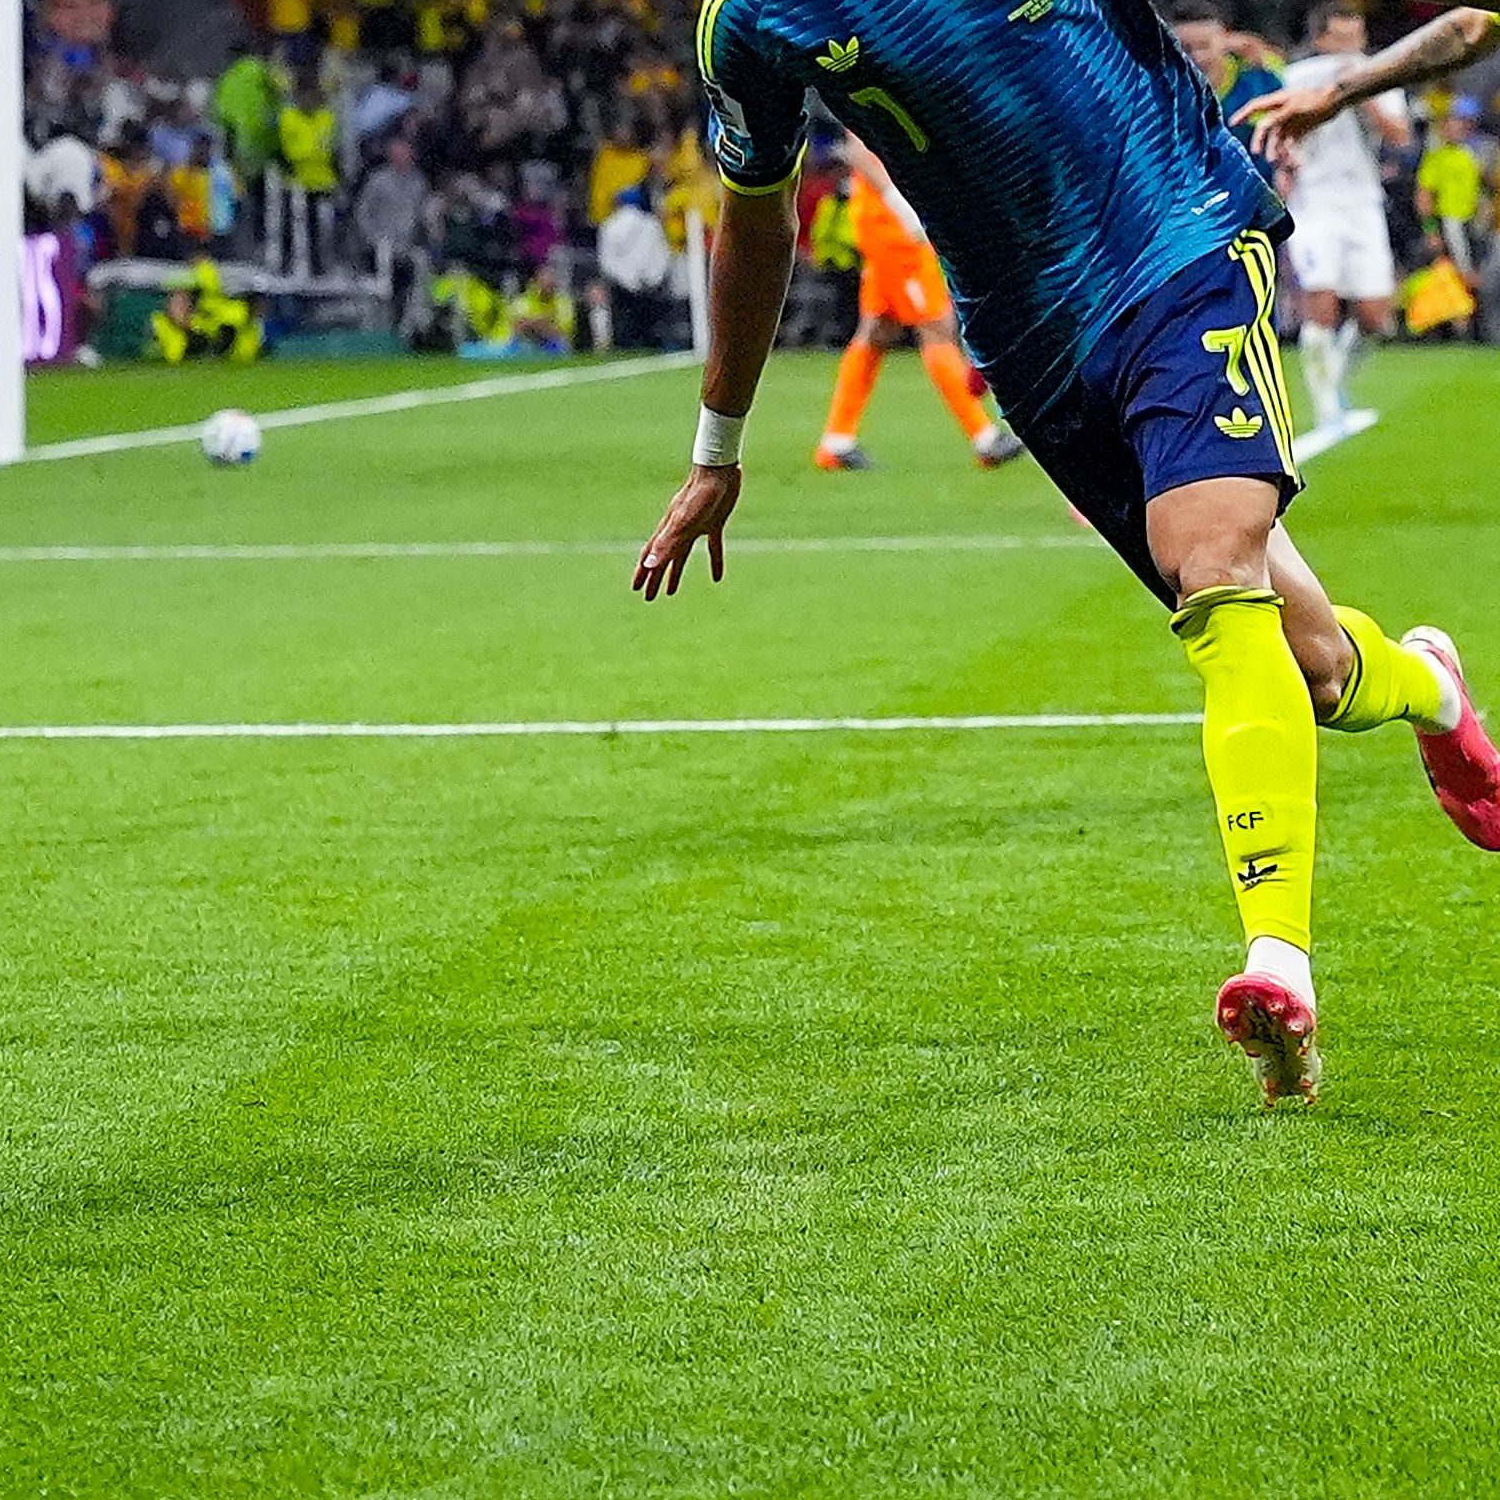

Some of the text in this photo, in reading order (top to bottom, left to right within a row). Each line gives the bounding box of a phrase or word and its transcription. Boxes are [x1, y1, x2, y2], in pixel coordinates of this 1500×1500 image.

[848, 87, 929, 153] 7
[1202, 324, 1250, 396] 7
[1227, 811, 1264, 832] FCF
